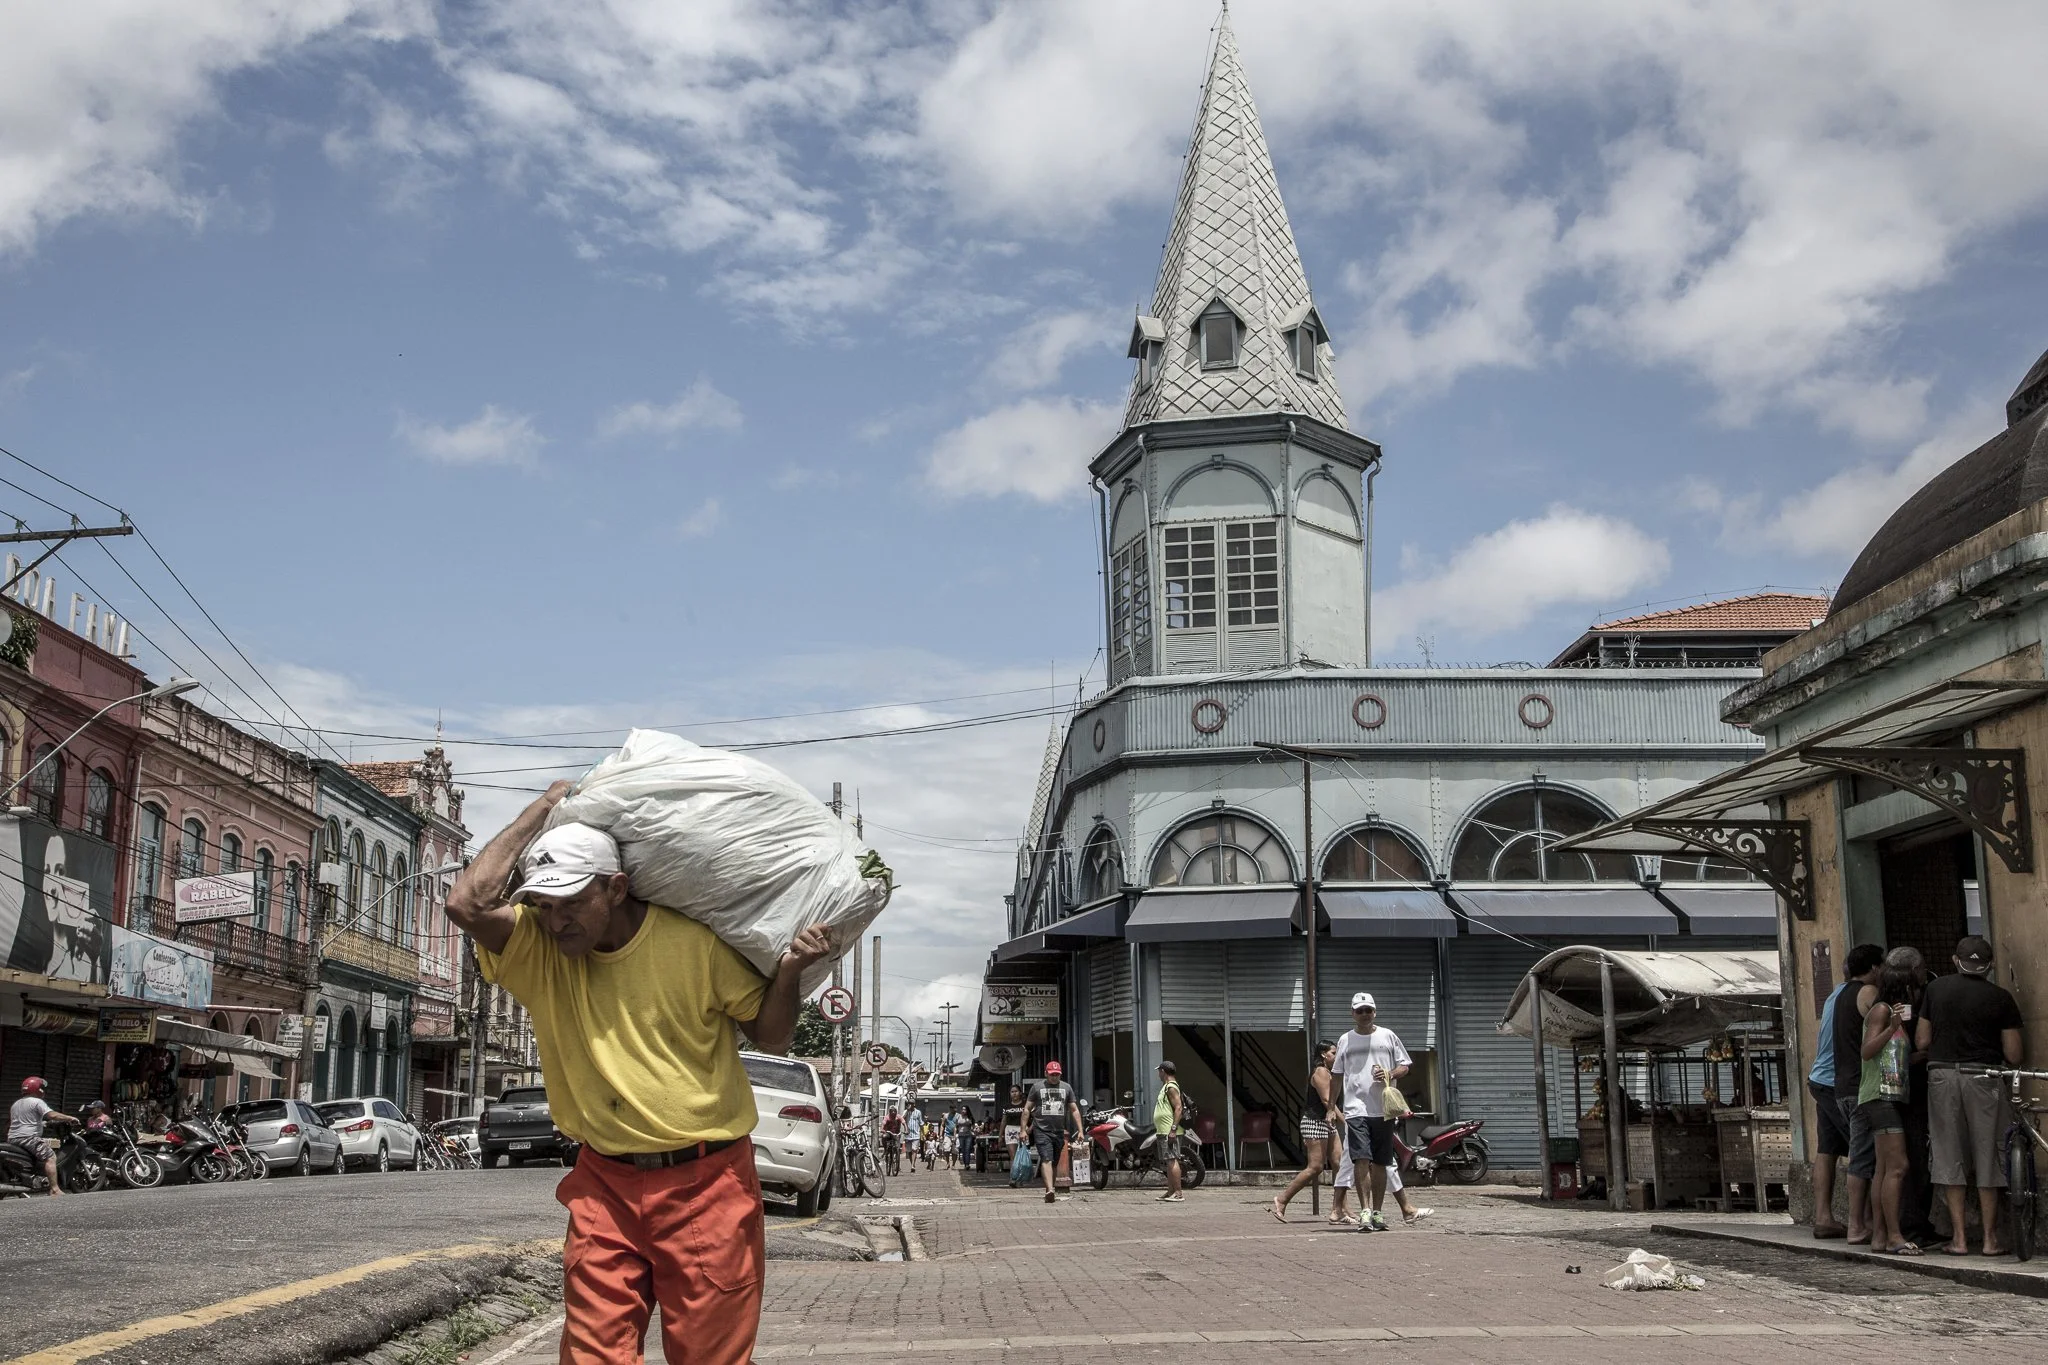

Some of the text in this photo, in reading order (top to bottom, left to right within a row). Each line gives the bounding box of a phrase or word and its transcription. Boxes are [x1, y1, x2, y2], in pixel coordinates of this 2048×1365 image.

[4, 552, 130, 662] BOA FAMA
[190, 887, 243, 902] RABELO
[1030, 987, 1057, 996] Livre
[831, 994, 843, 1015] E
